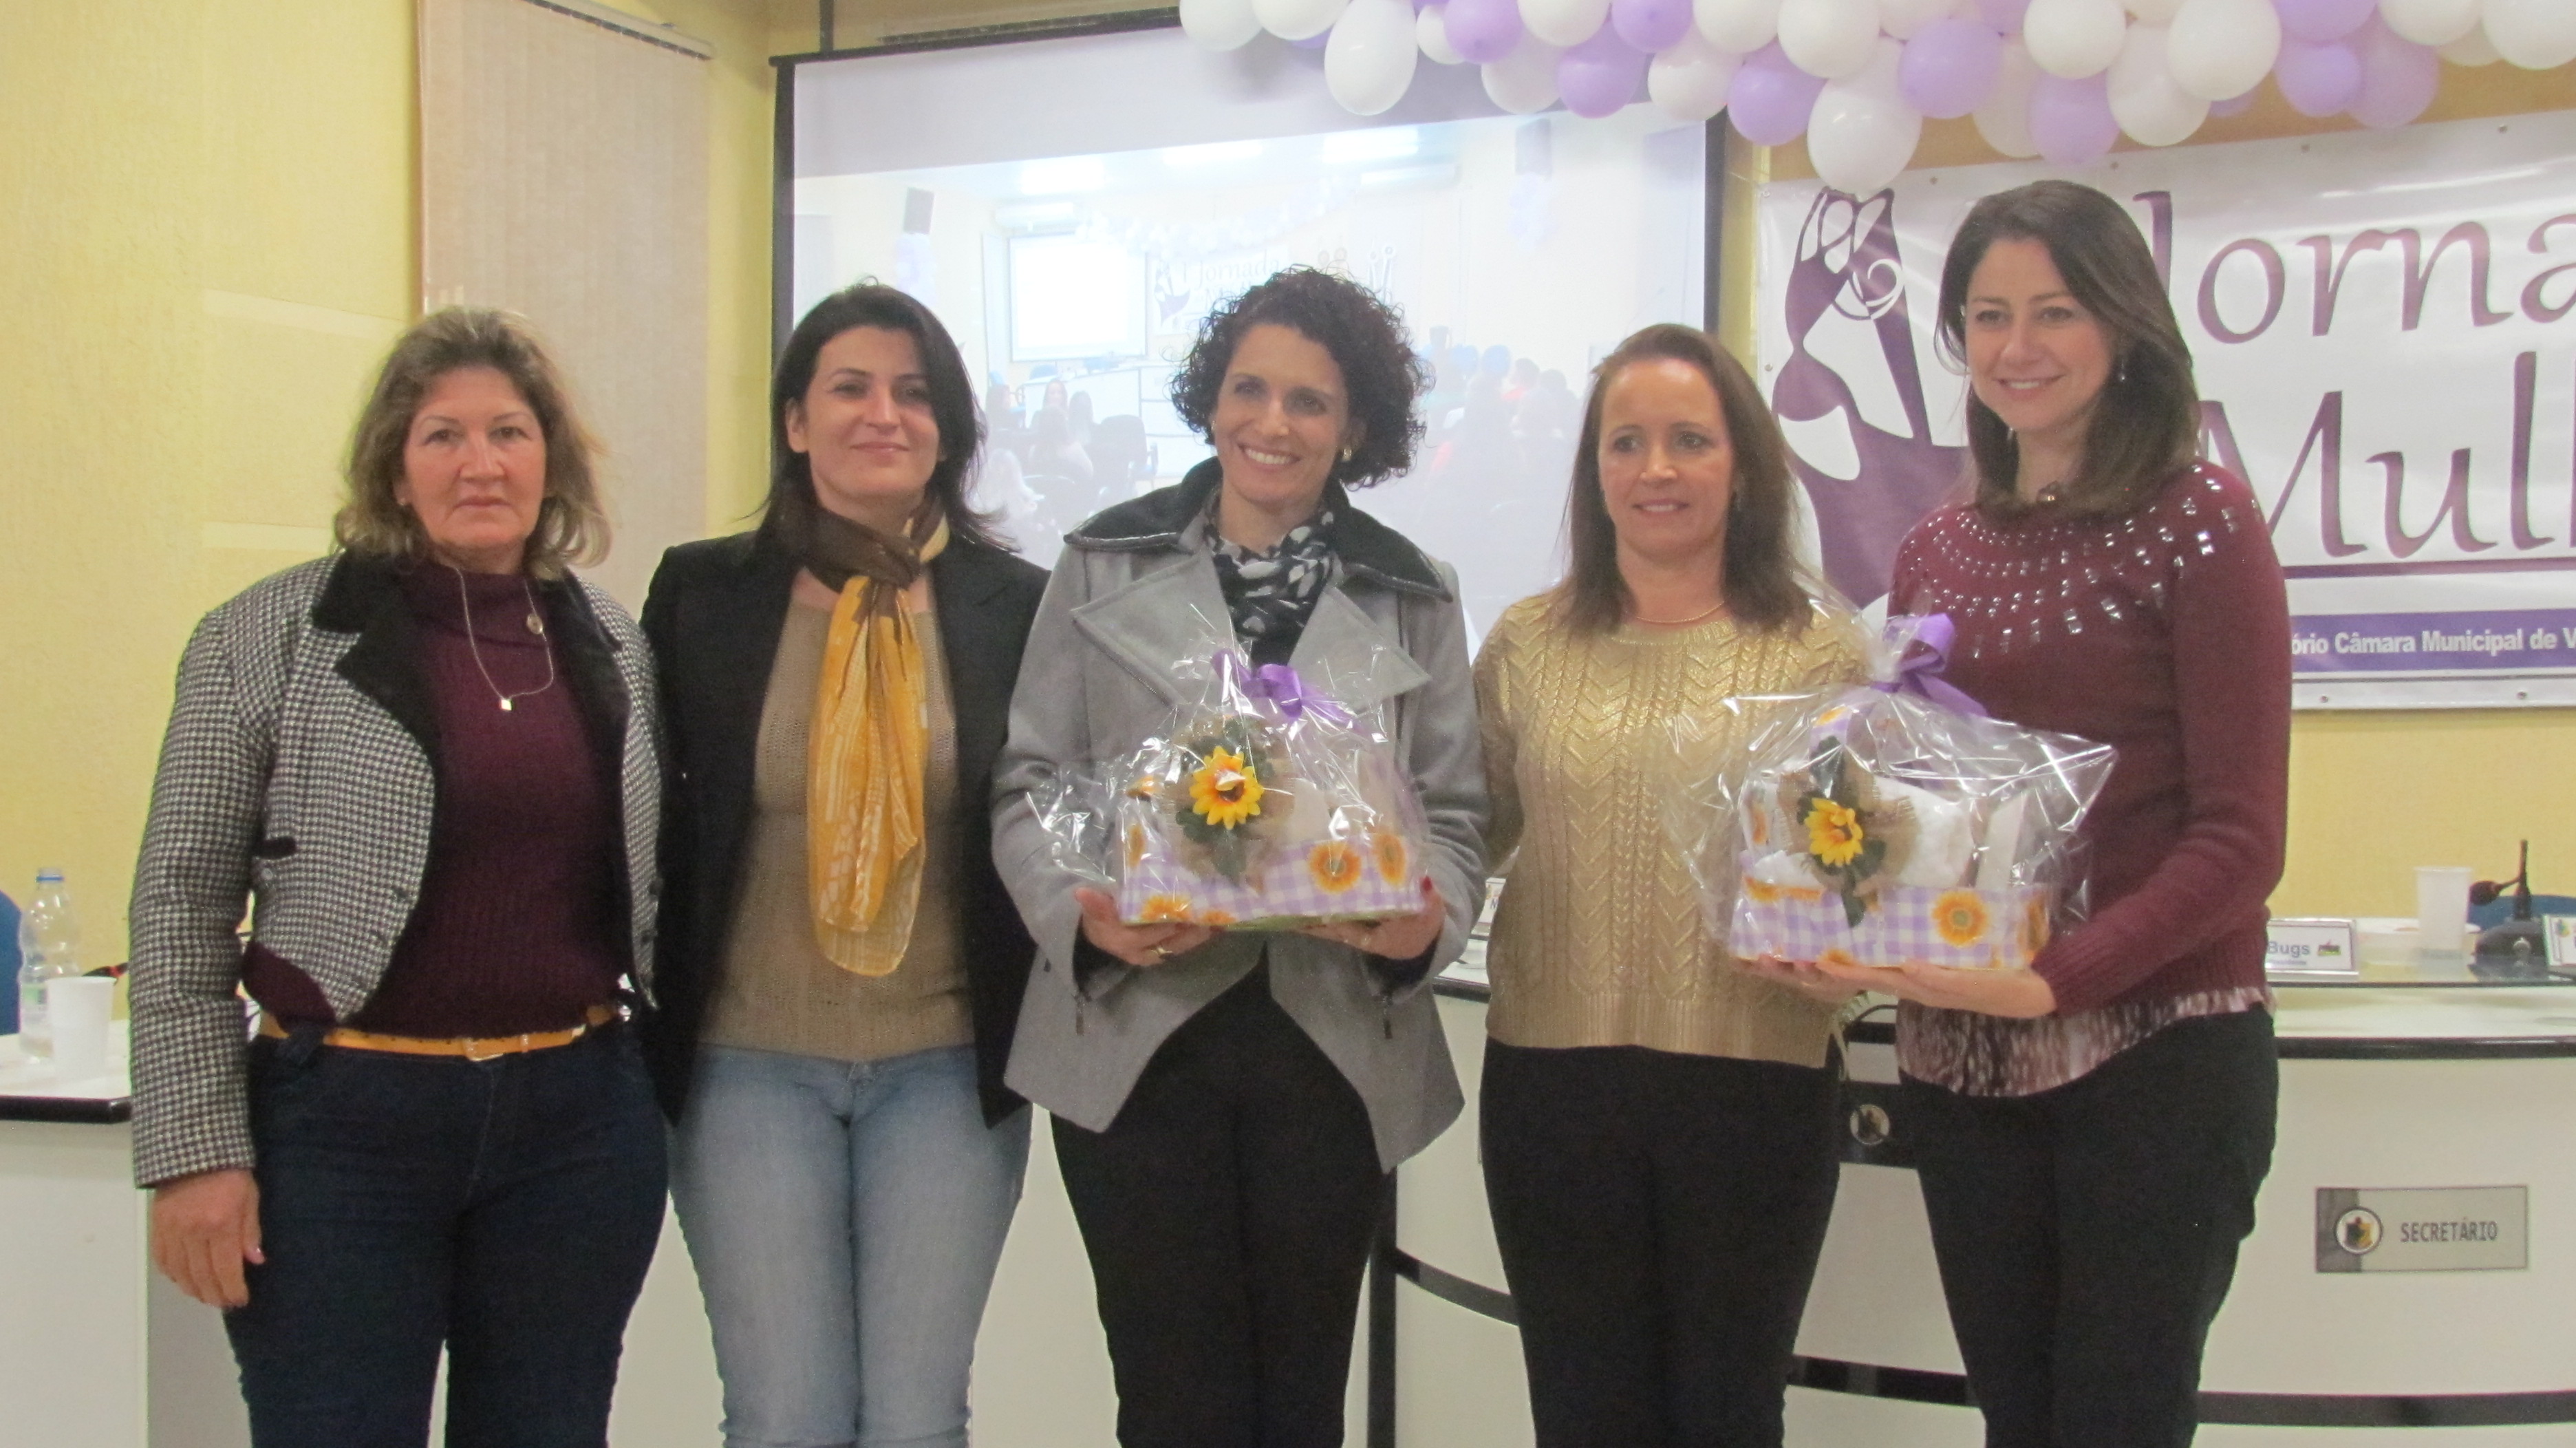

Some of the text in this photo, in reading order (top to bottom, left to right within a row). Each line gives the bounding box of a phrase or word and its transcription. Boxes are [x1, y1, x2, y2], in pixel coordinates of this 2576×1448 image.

[2198, 351, 2576, 559] Mul
[2334, 631, 2416, 654] Câmara
[2421, 628, 2523, 657] Municipal
[2529, 627, 2557, 650] de
[2267, 940, 2310, 958] Bugs
[2400, 1216, 2499, 1243] SECRETÁRIO
